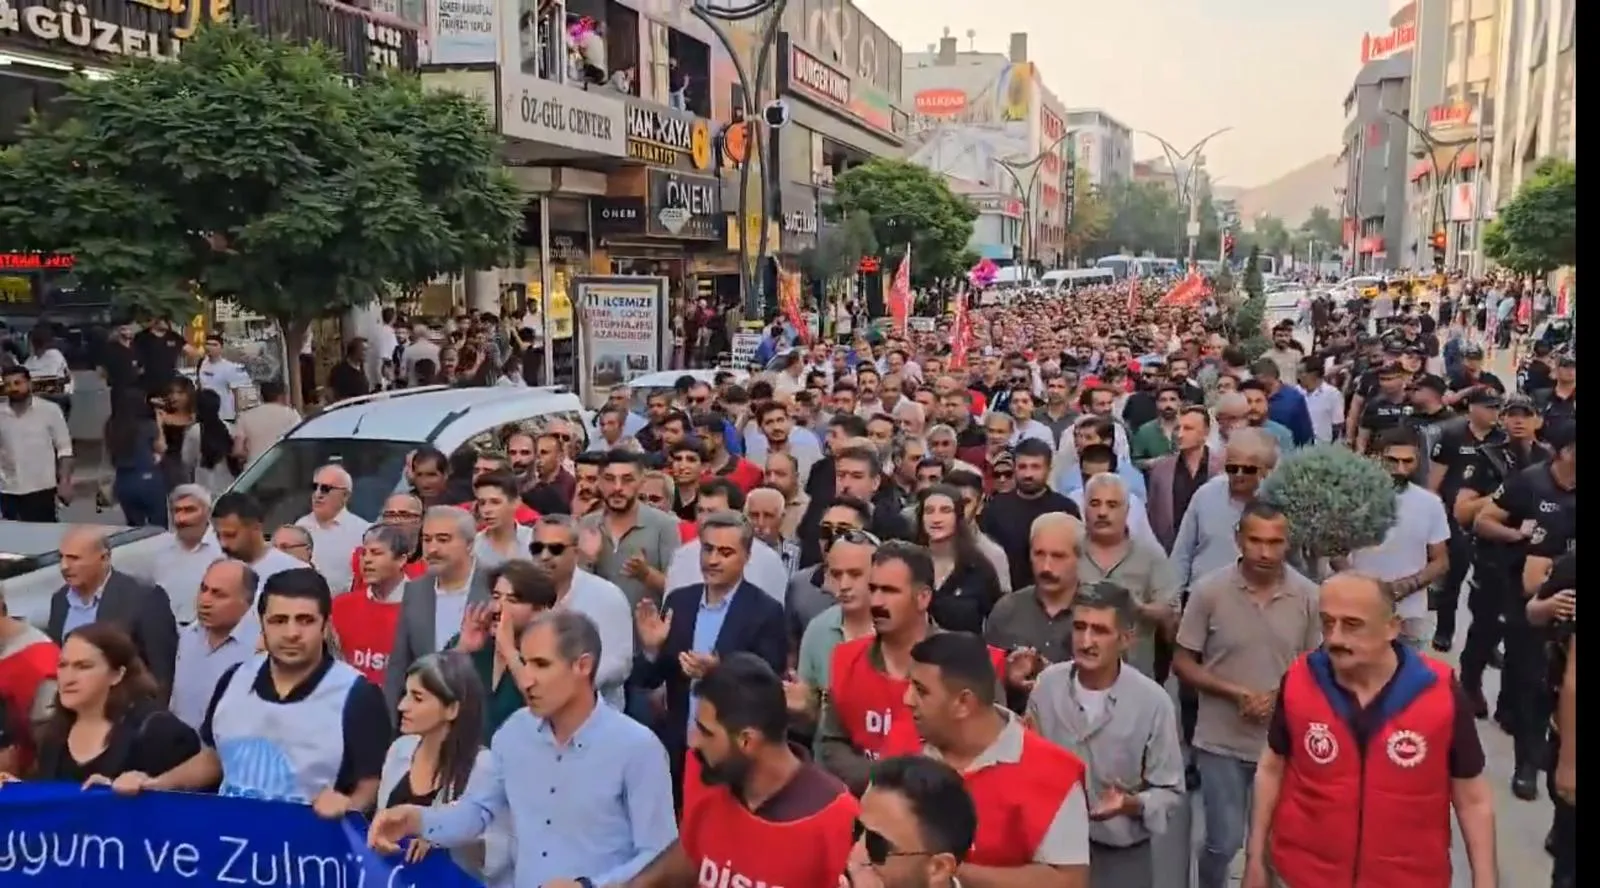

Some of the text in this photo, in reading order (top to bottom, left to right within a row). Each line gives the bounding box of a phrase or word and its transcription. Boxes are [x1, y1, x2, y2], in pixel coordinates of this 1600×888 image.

[521, 88, 612, 141] ÖZ-GÜL CENTER
[602, 207, 637, 219] ÖNEM
[144, 838, 200, 878] ve
[698, 854, 786, 888] DİS
